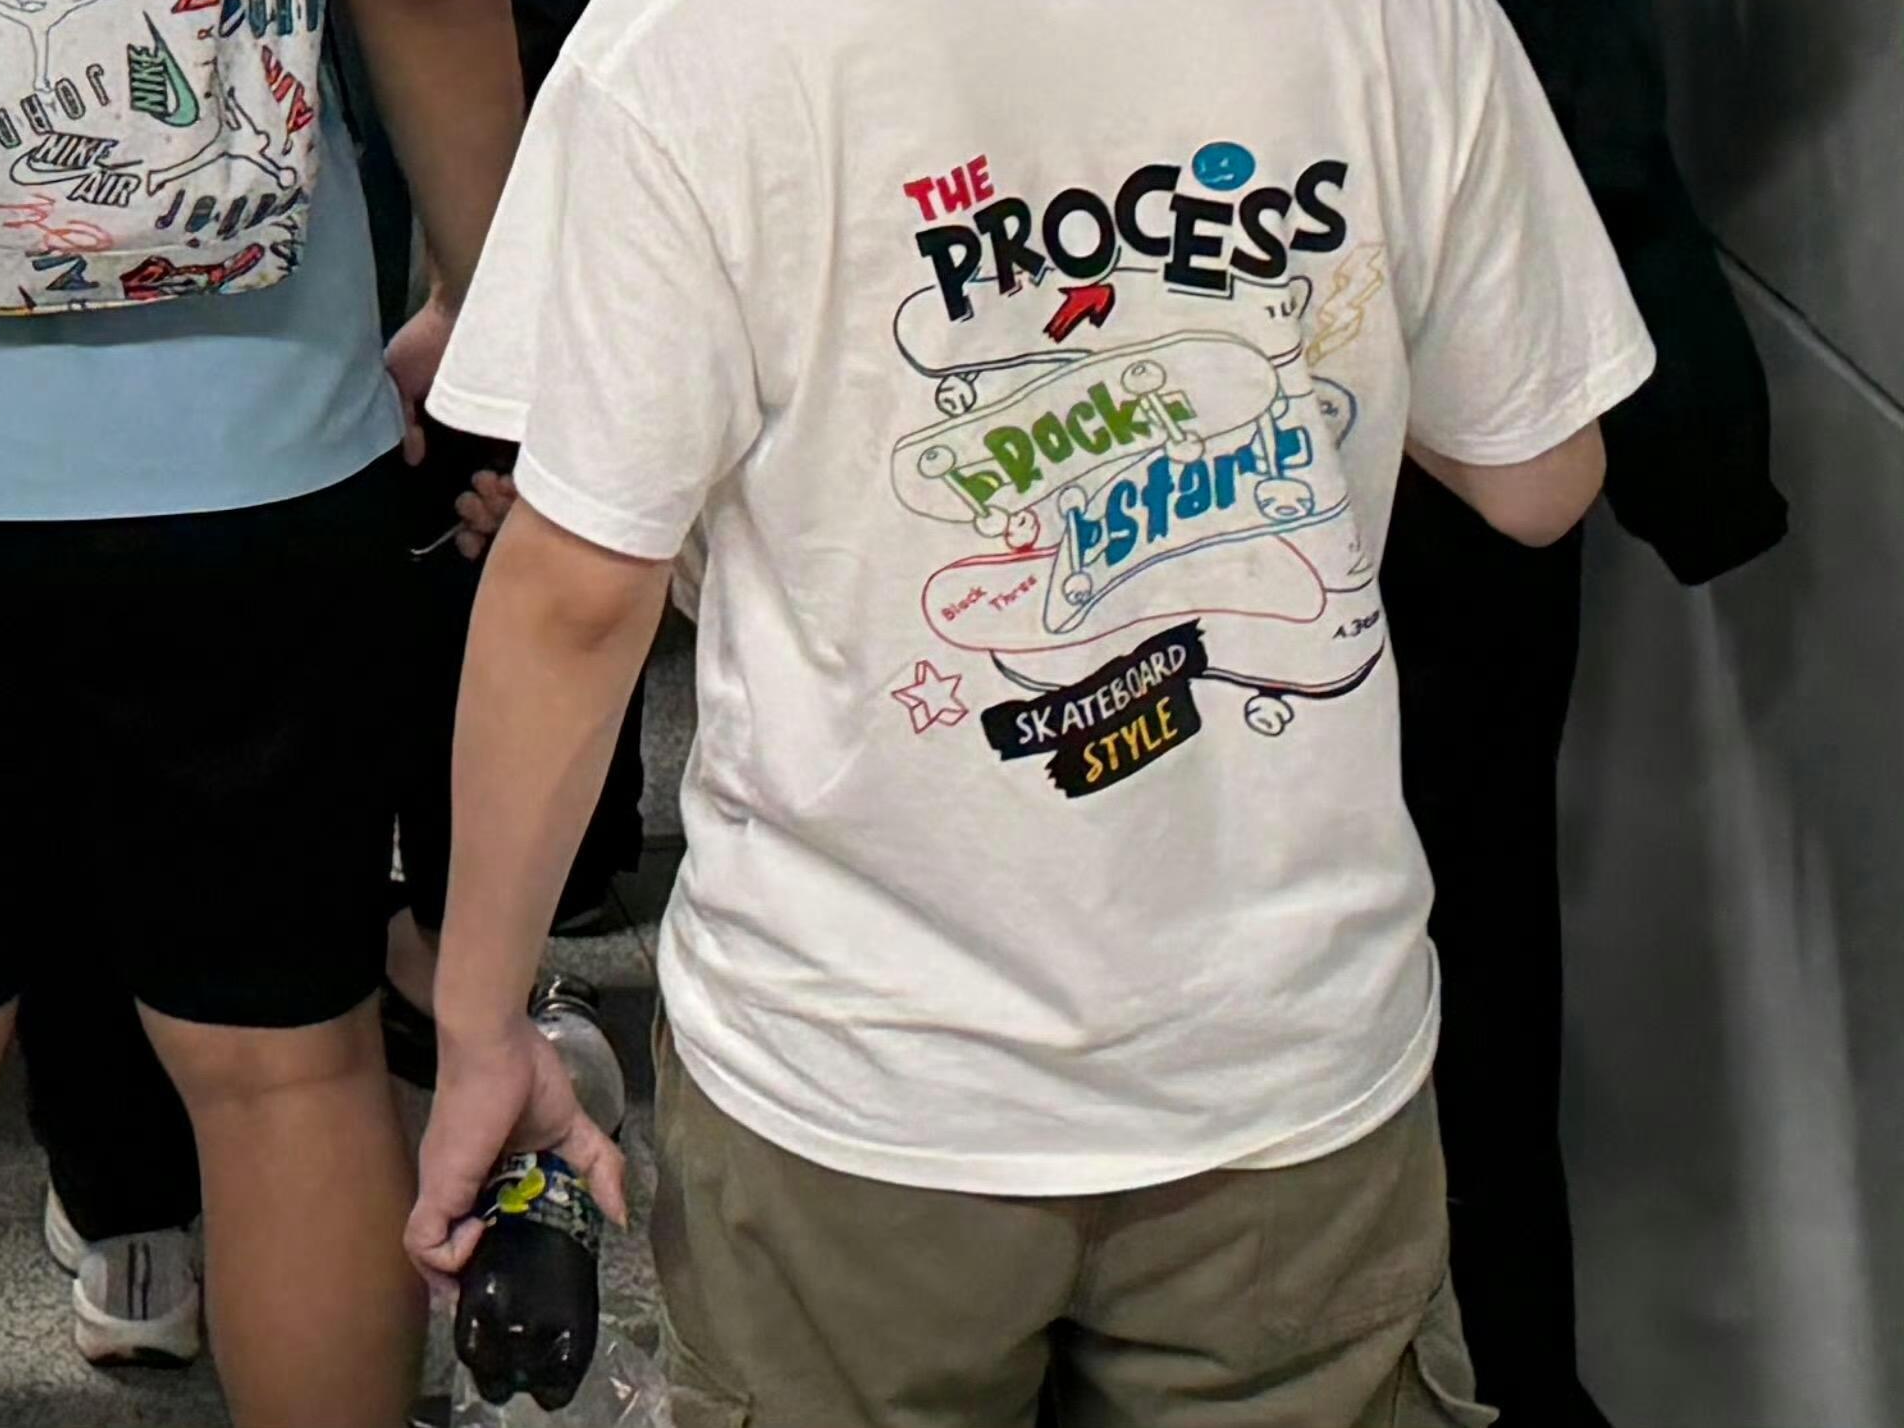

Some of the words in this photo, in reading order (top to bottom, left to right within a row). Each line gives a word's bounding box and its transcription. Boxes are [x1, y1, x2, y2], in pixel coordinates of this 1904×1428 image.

[34, 132, 120, 170] NIKE
[67, 170, 142, 208] AIR
[903, 155, 995, 222] THE
[915, 160, 1349, 322] PROCESS
[1016, 641, 1187, 745] SKATEBOARD
[1082, 698, 1180, 785] STYLE
